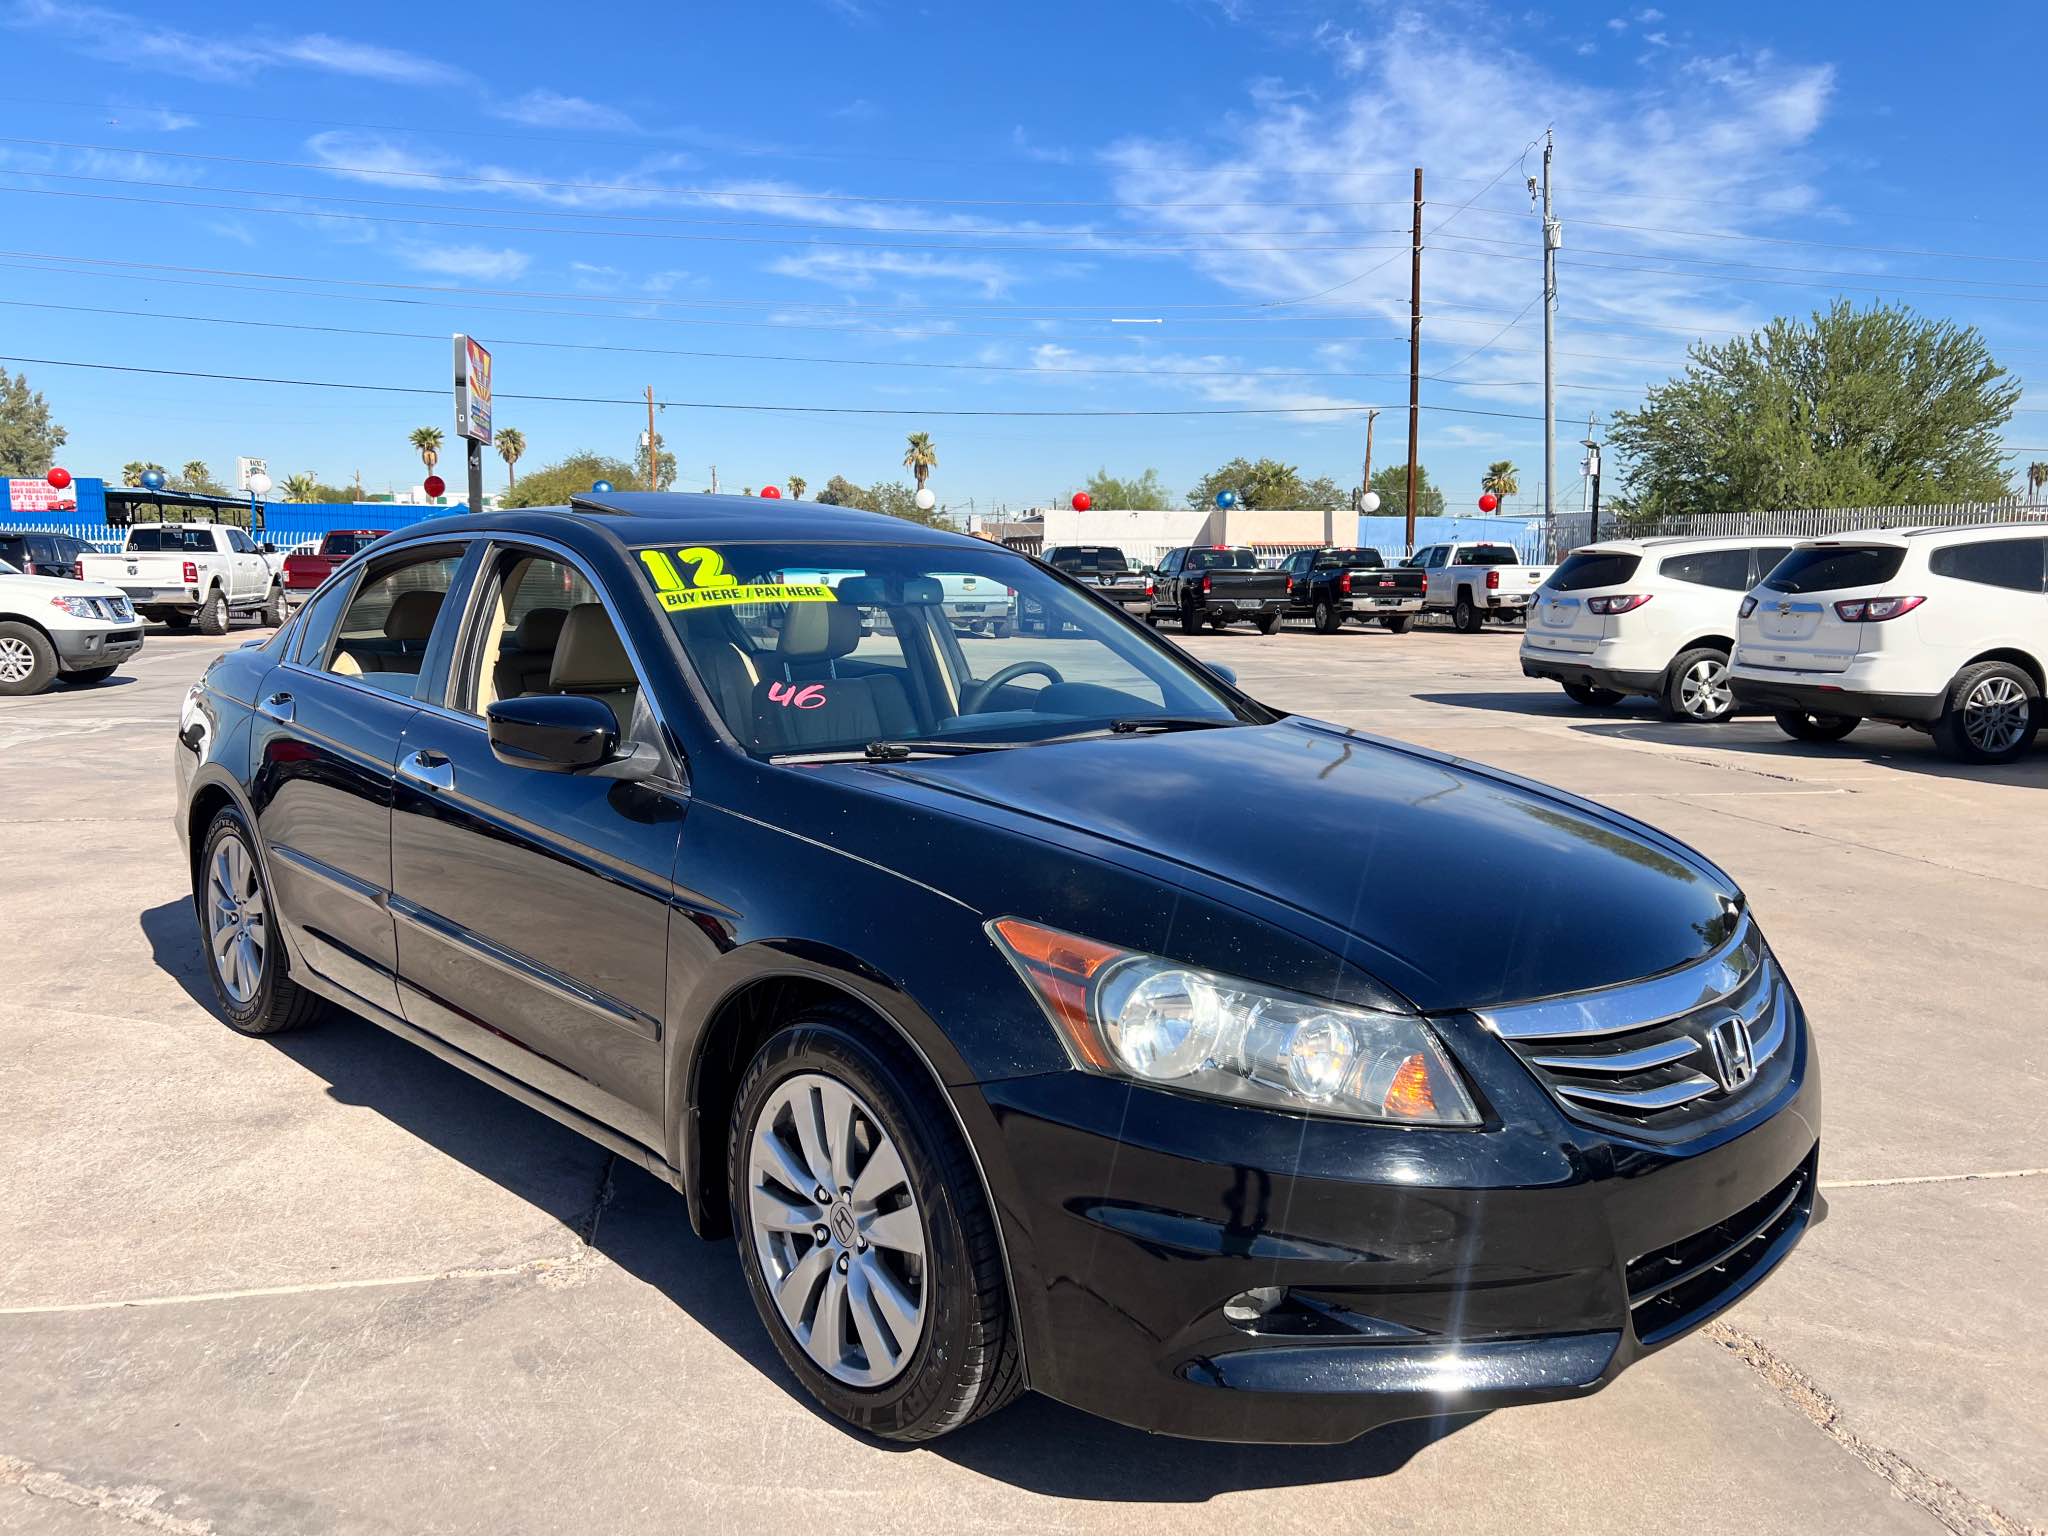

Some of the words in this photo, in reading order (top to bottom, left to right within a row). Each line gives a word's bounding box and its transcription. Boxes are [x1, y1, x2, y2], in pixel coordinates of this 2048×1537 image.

[640, 547, 738, 591] 12
[666, 592, 696, 606] BUY
[702, 588, 741, 601] HERE
[755, 587, 782, 598] PAY
[787, 586, 825, 597] HERE
[768, 681, 826, 709] 46
[204, 818, 240, 854] GOODYEAR
